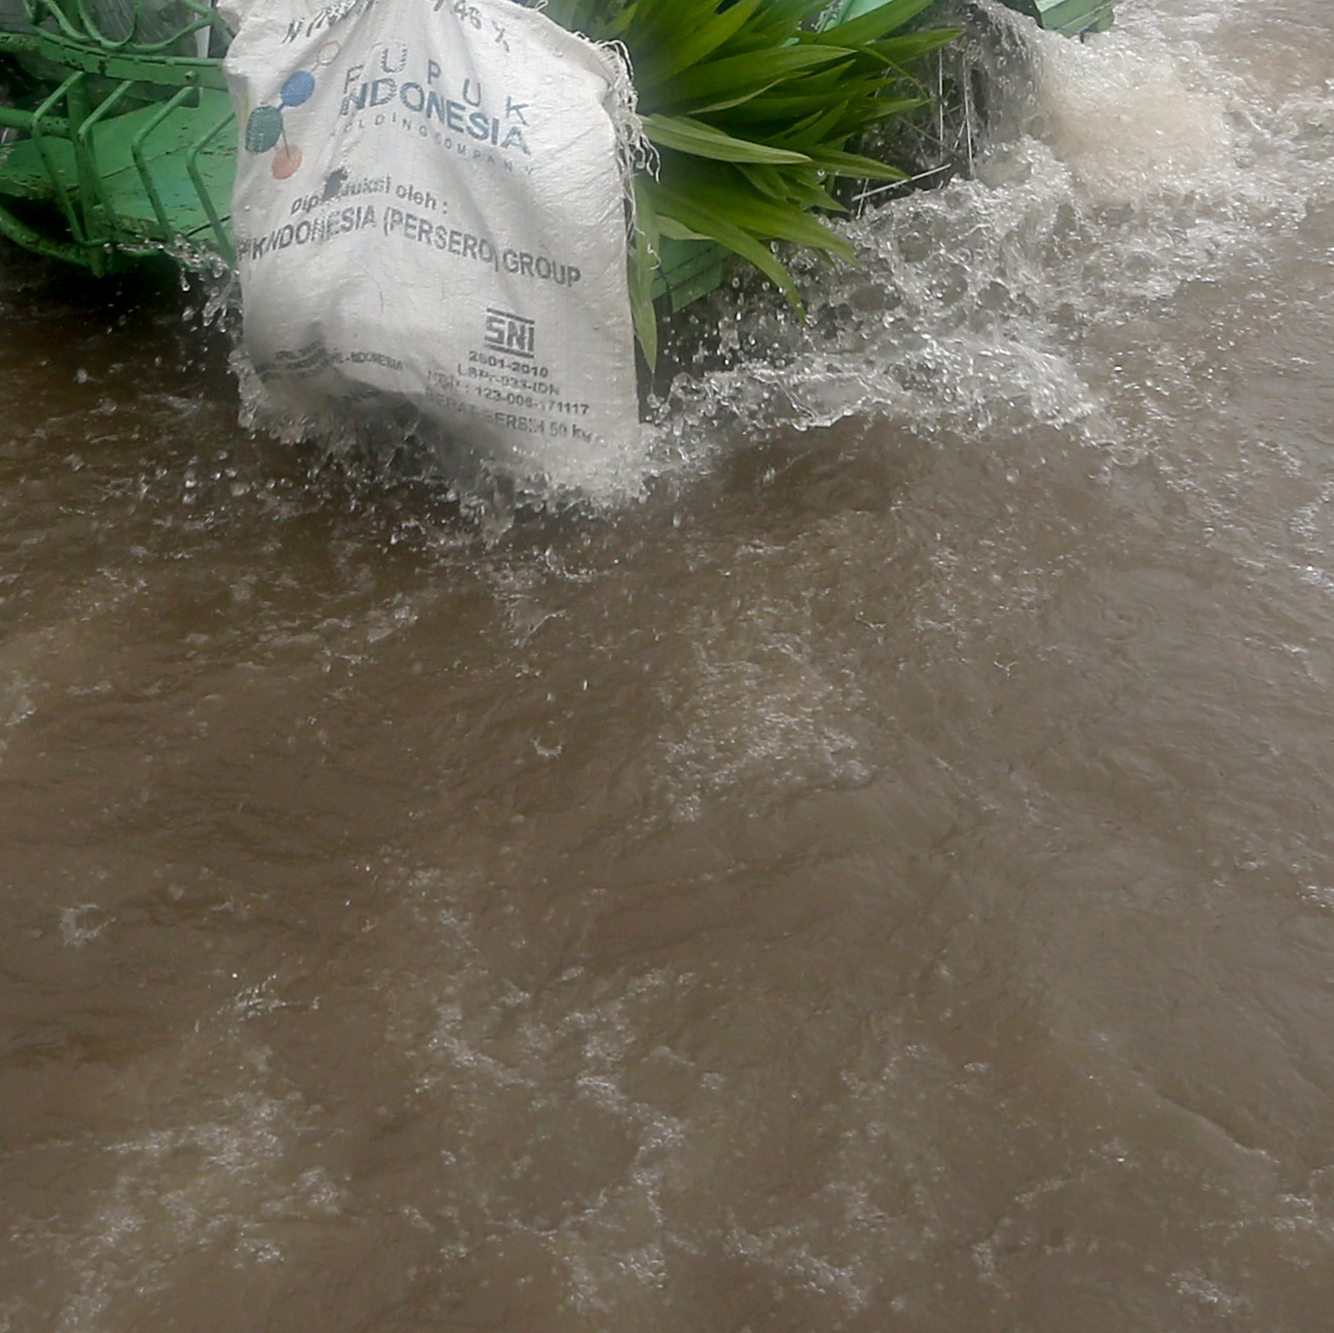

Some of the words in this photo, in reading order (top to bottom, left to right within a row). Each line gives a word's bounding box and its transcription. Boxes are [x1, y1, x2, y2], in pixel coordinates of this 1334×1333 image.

[290, 176, 392, 216] Dipuksi
[503, 249, 581, 287] GROUP
[484, 314, 535, 353] SNI
